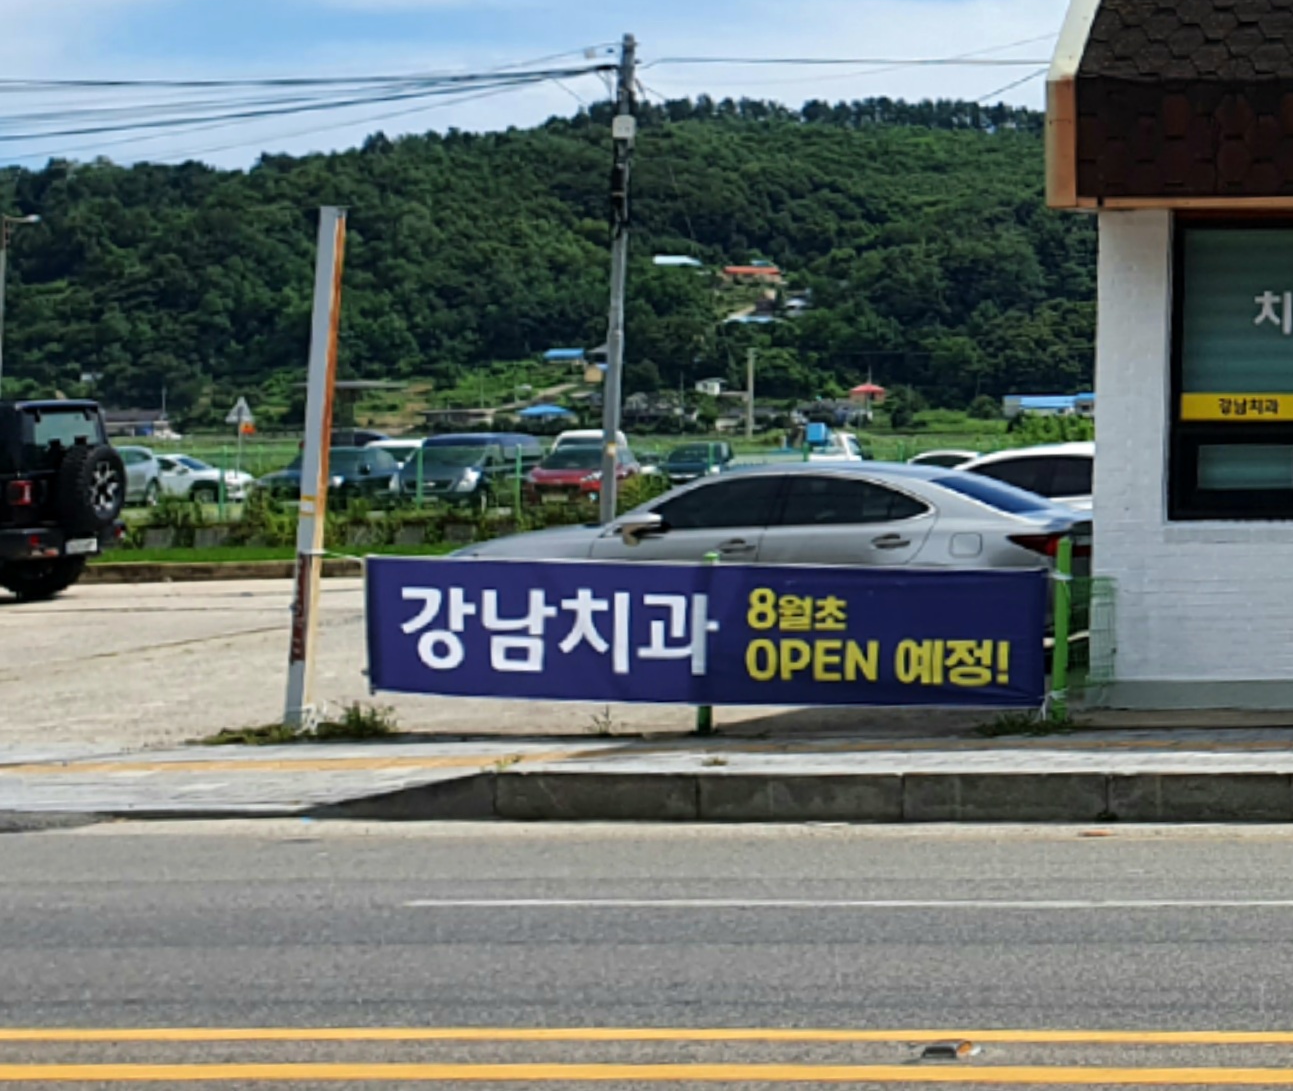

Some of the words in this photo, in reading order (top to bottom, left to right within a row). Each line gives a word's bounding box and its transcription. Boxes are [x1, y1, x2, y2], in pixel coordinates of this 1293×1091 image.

[1218, 397, 1279, 415] 강남치과
[400, 586, 719, 674] 강남치과
[746, 587, 848, 631] 8월초
[745, 638, 880, 682] OPEN
[895, 638, 1010, 687] 예정!
